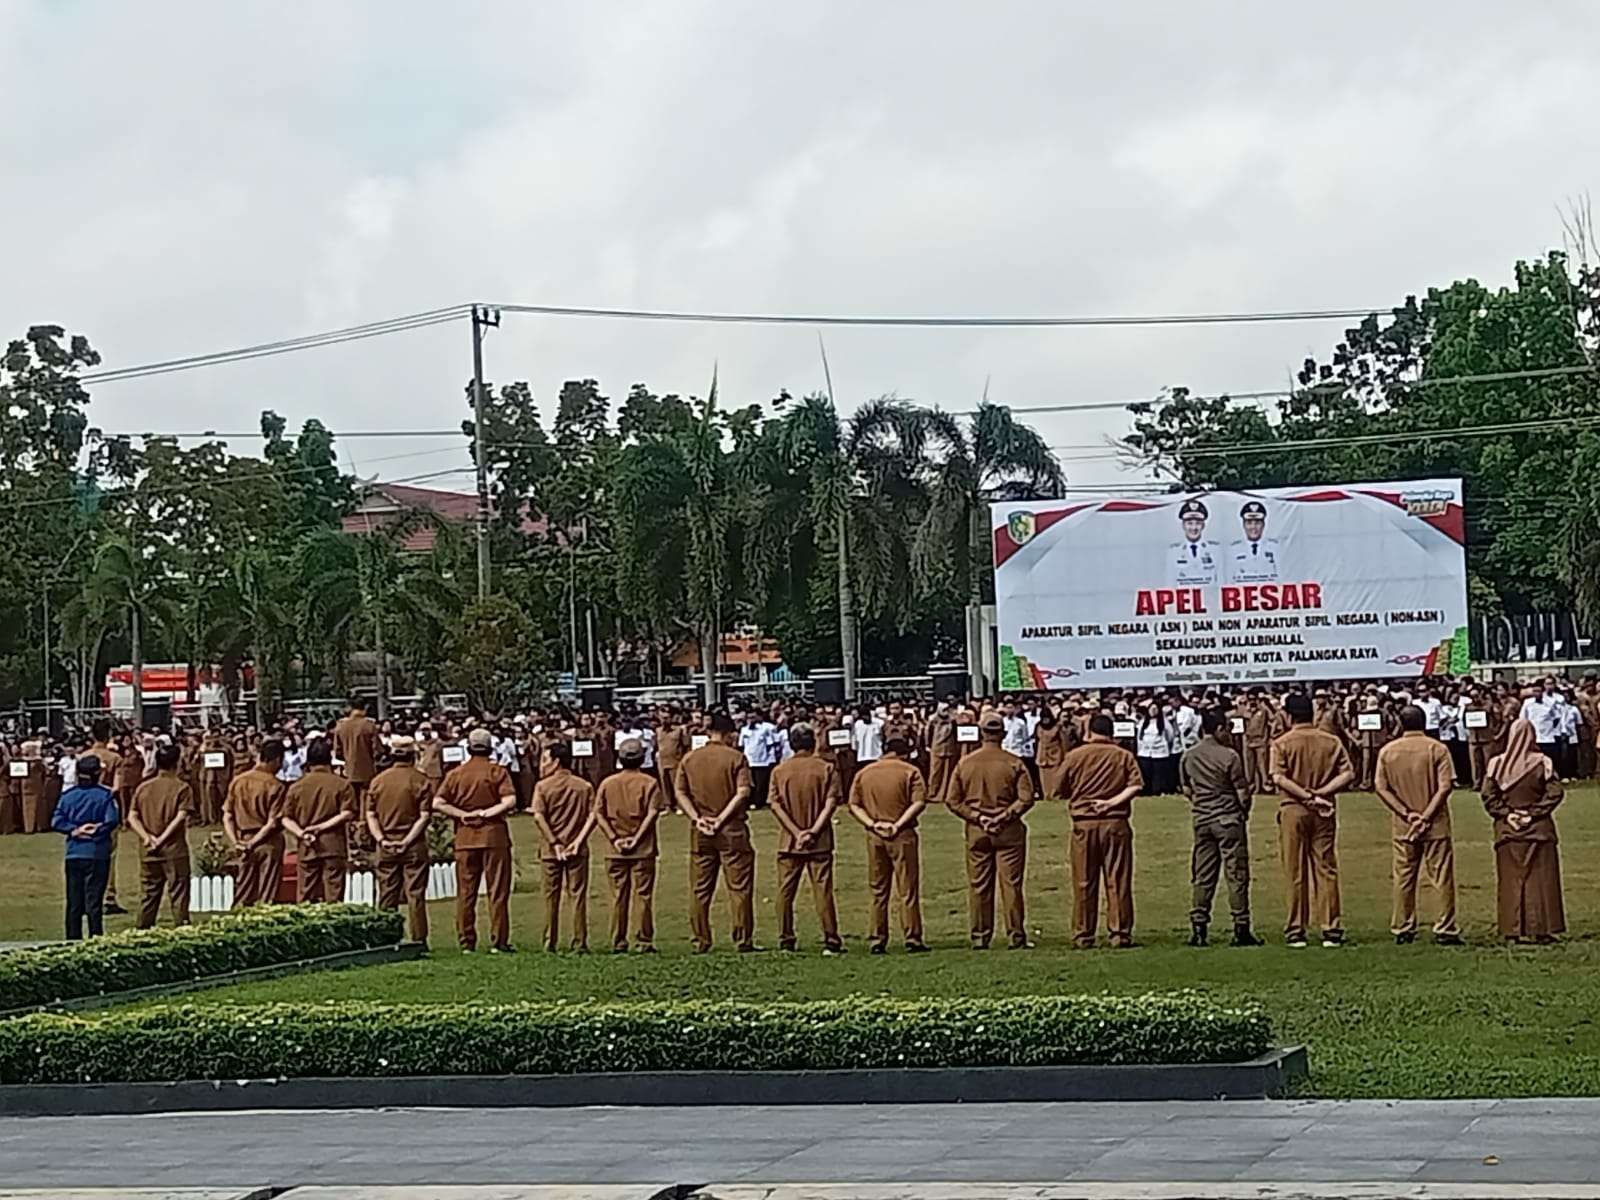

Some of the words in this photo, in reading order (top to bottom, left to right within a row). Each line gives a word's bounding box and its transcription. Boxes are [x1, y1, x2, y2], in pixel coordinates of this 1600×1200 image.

[1136, 588, 1207, 616] APEL
[1221, 583, 1322, 613] BESAR
[1021, 626, 1073, 638] APARATUR
[1078, 625, 1103, 636] SIPIL
[1108, 623, 1149, 635] NEGARA
[1192, 620, 1213, 632] DAN
[1219, 619, 1241, 630] NON
[1246, 617, 1299, 630] APARATUR
[1305, 615, 1331, 627] SIPIL
[1336, 613, 1379, 625] NEGARA
[1156, 638, 1216, 650] SEKALIGUS
[1222, 634, 1304, 647] HALALBIHALAL
[1085, 659, 1096, 670] DI
[1102, 656, 1173, 669] LINGKUNGAN
[1179, 651, 1248, 666] PEMERINTAH
[1253, 651, 1283, 663] KOTA
[1288, 648, 1347, 662] PALANGKA
[1350, 647, 1379, 660] RAYA
